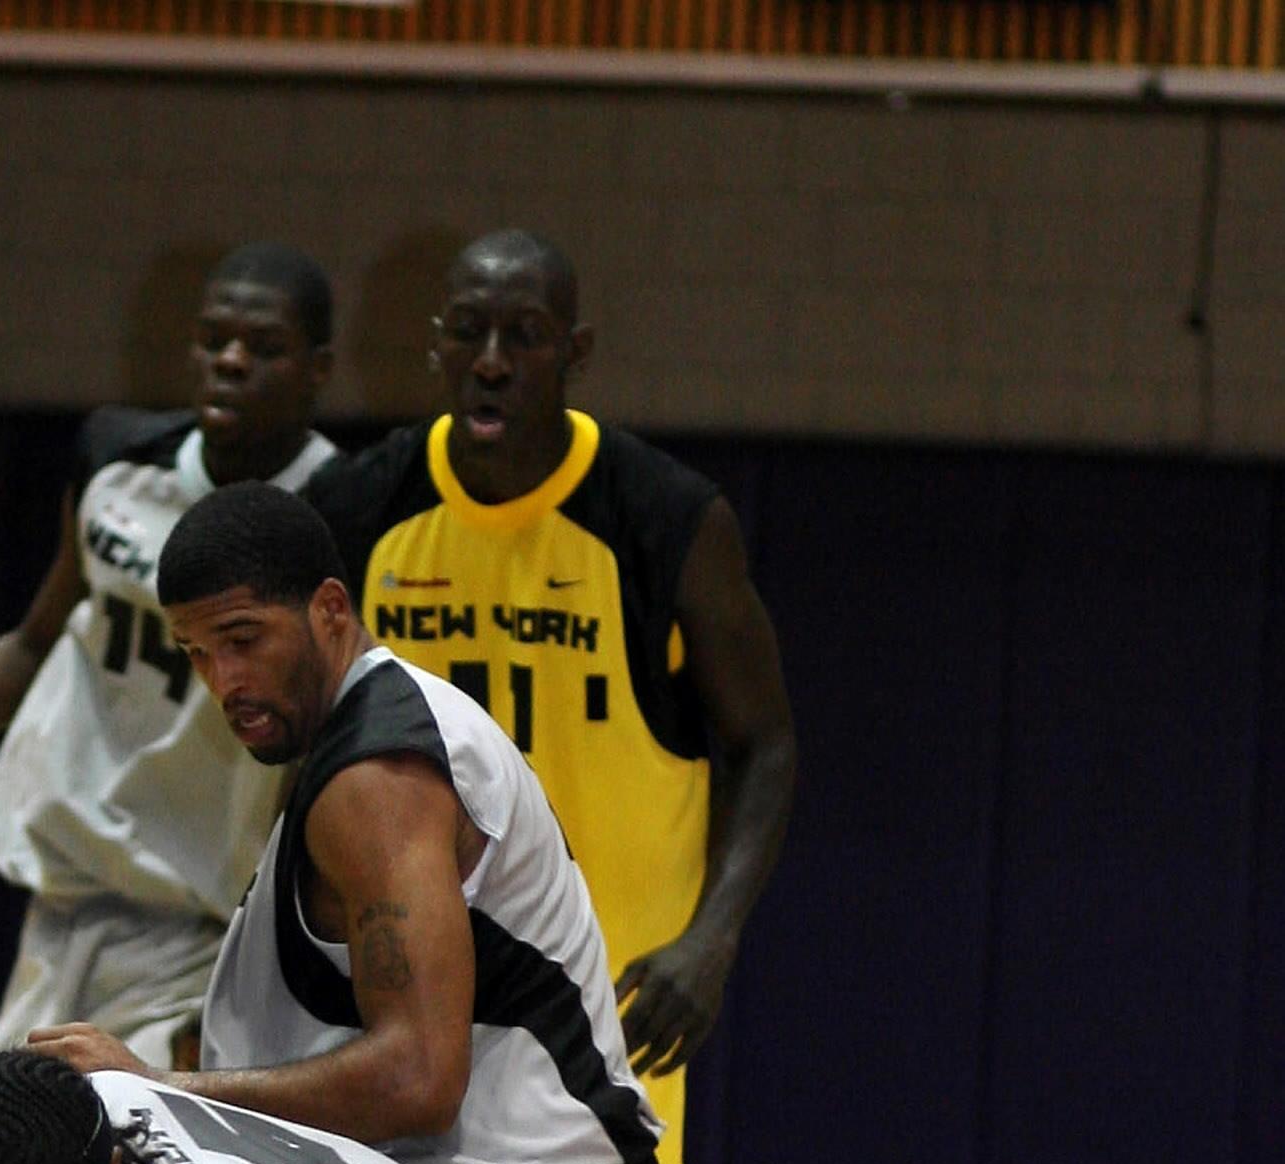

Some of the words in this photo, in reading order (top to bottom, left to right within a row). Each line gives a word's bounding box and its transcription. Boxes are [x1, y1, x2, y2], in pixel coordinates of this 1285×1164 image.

[103, 593, 192, 705] 14
[376, 604, 476, 640] NEW
[493, 603, 600, 653] YORK
